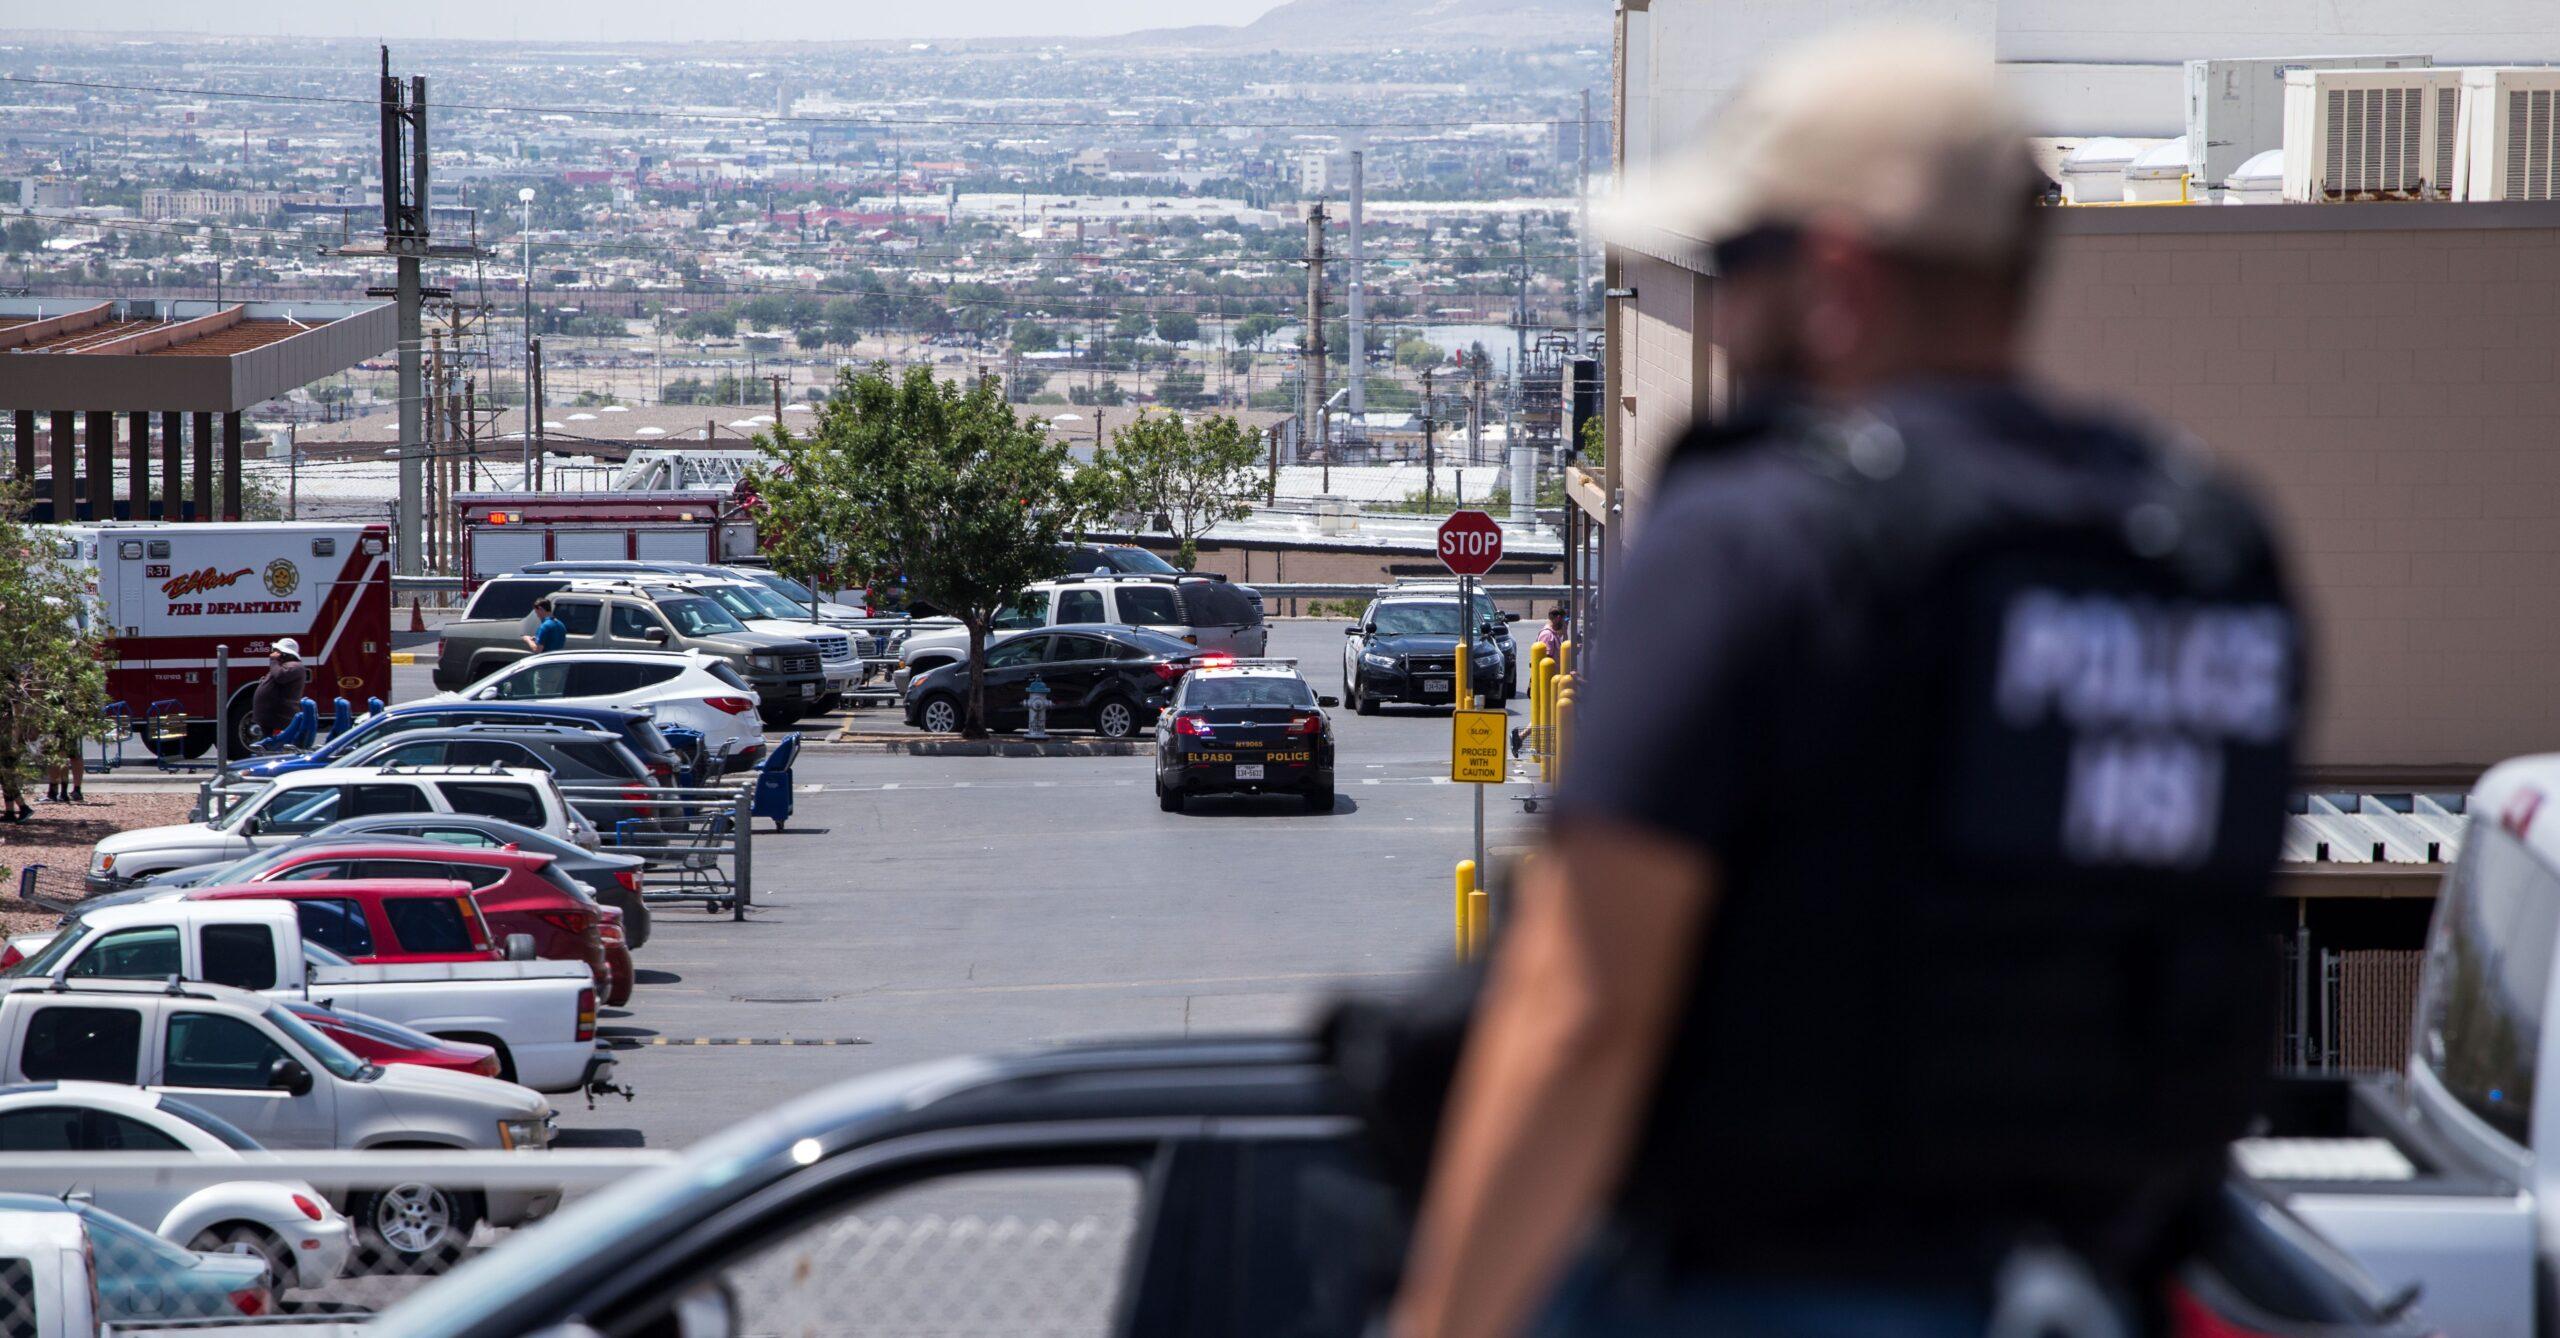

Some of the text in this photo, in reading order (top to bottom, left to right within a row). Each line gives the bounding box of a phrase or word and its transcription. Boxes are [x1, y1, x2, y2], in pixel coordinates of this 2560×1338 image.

[1442, 531, 1498, 555] STOP
[147, 566, 169, 576] R-37
[167, 601, 302, 615] FIRE DEPARTMENT
[1998, 594, 2285, 739] POLICE
[1188, 752, 1233, 762] EL PASO
[1267, 752, 1310, 761] POLICE
[1462, 748, 1497, 756] PROCEED
[1470, 758, 1488, 766] WITH
[1462, 768, 1495, 777] CAUTION
